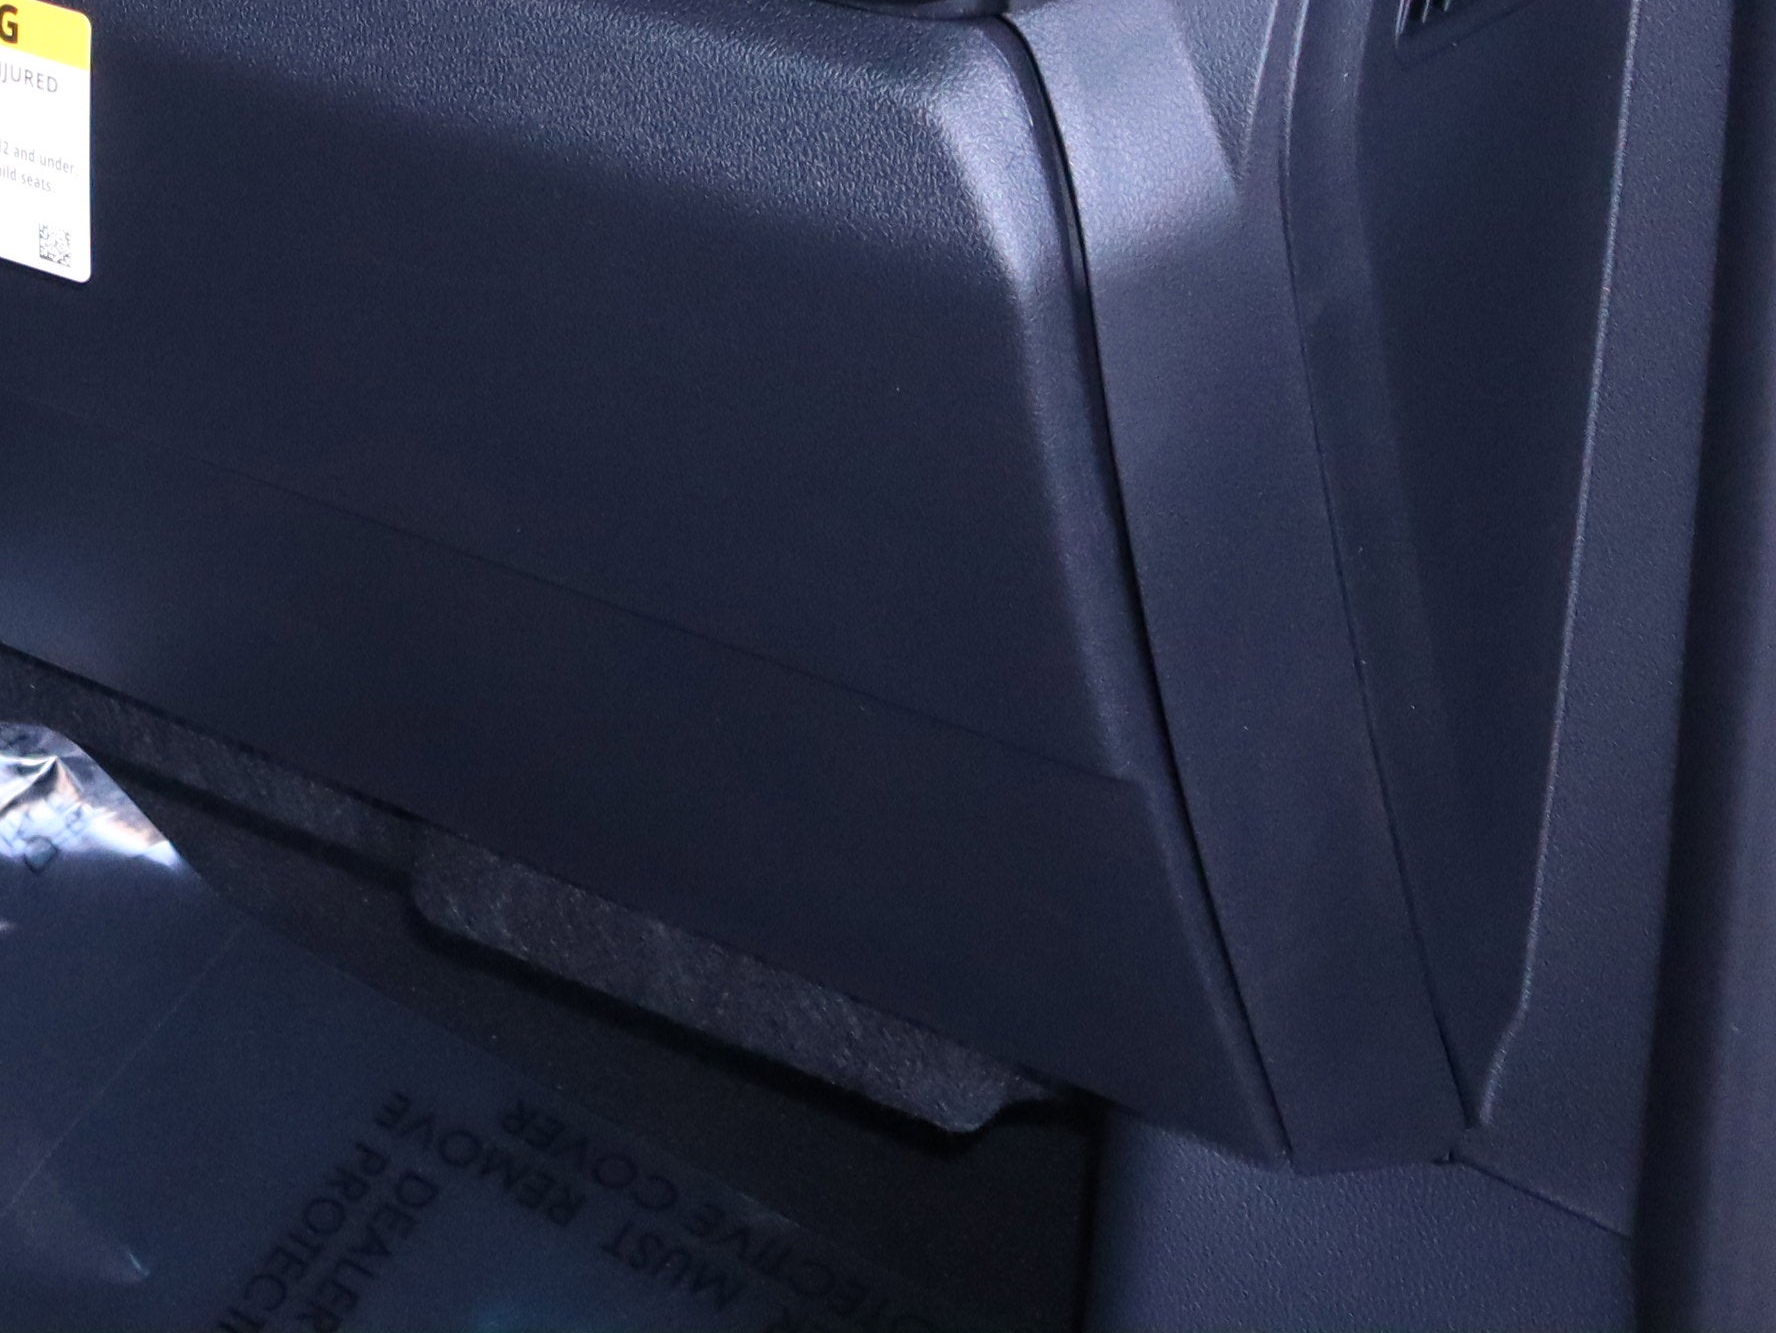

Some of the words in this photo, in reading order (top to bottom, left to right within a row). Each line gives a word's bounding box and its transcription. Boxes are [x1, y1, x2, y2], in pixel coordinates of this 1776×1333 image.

[13, 146, 35, 163] and
[39, 155, 79, 177] under.
[21, 172, 56, 194] seats.
[374, 1091, 578, 1231] REMOVE
[490, 1100, 671, 1214] COVER
[590, 1221, 740, 1311] MUST
